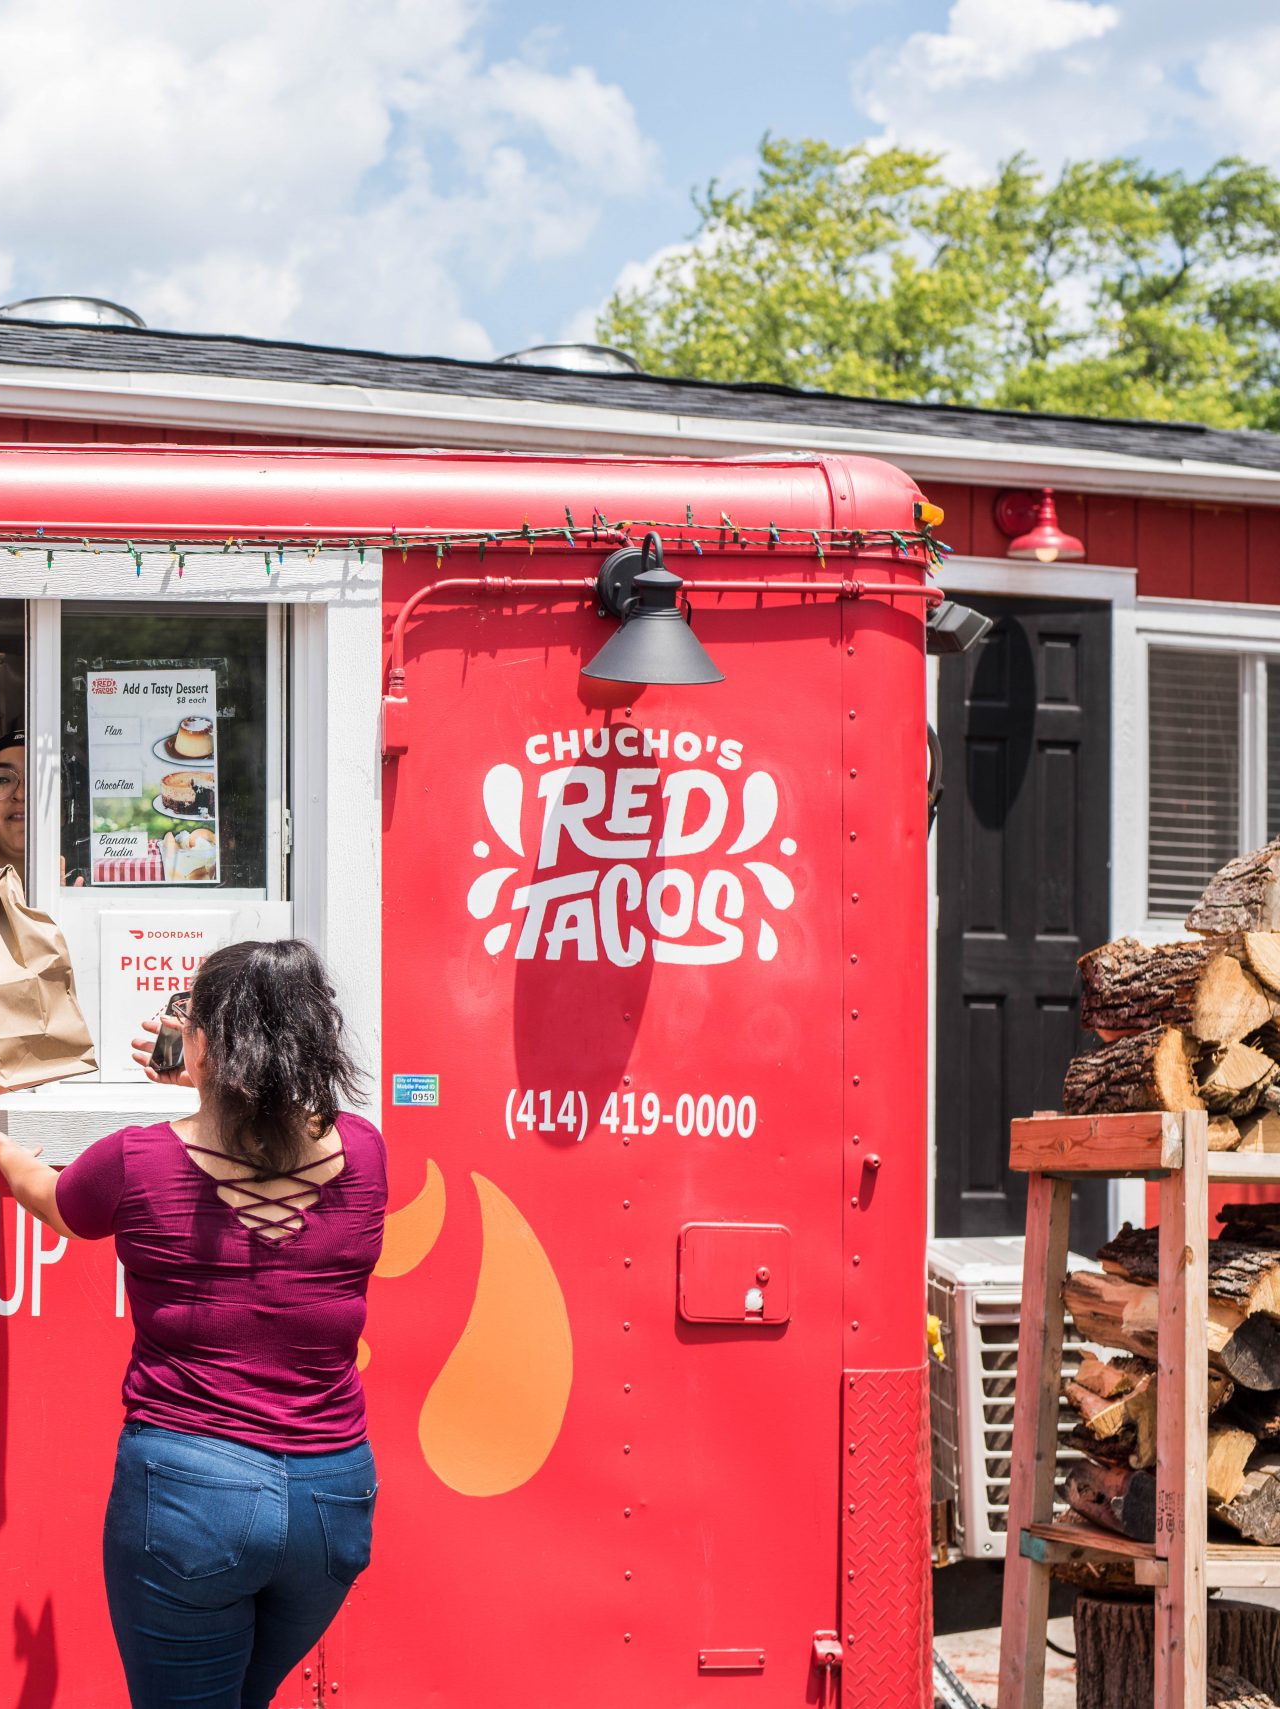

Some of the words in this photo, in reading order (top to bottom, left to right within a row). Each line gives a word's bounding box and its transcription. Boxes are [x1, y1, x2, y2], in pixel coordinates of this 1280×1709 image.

[122, 682, 140, 695] Add
[143, 686, 148, 694] a
[151, 682, 173, 697] Tasty
[176, 682, 208, 694] Dessert
[176, 696, 186, 704] $8
[188, 696, 207, 704] each
[104, 725, 122, 736] Flan
[525, 727, 744, 770] CHUCHO'S
[94, 779, 134, 790] ChocoFlan
[537, 764, 729, 870] RED
[99, 834, 138, 845] Banana
[103, 846, 133, 857] Pudin
[511, 864, 744, 967] TACOS
[147, 931, 203, 939] DOORDASH
[121, 956, 174, 971] PICK
[136, 976, 193, 991] HERE
[412, 1093, 434, 1101] 0959
[505, 1088, 588, 1141] (414)
[599, 1091, 757, 1138] 419-0000
